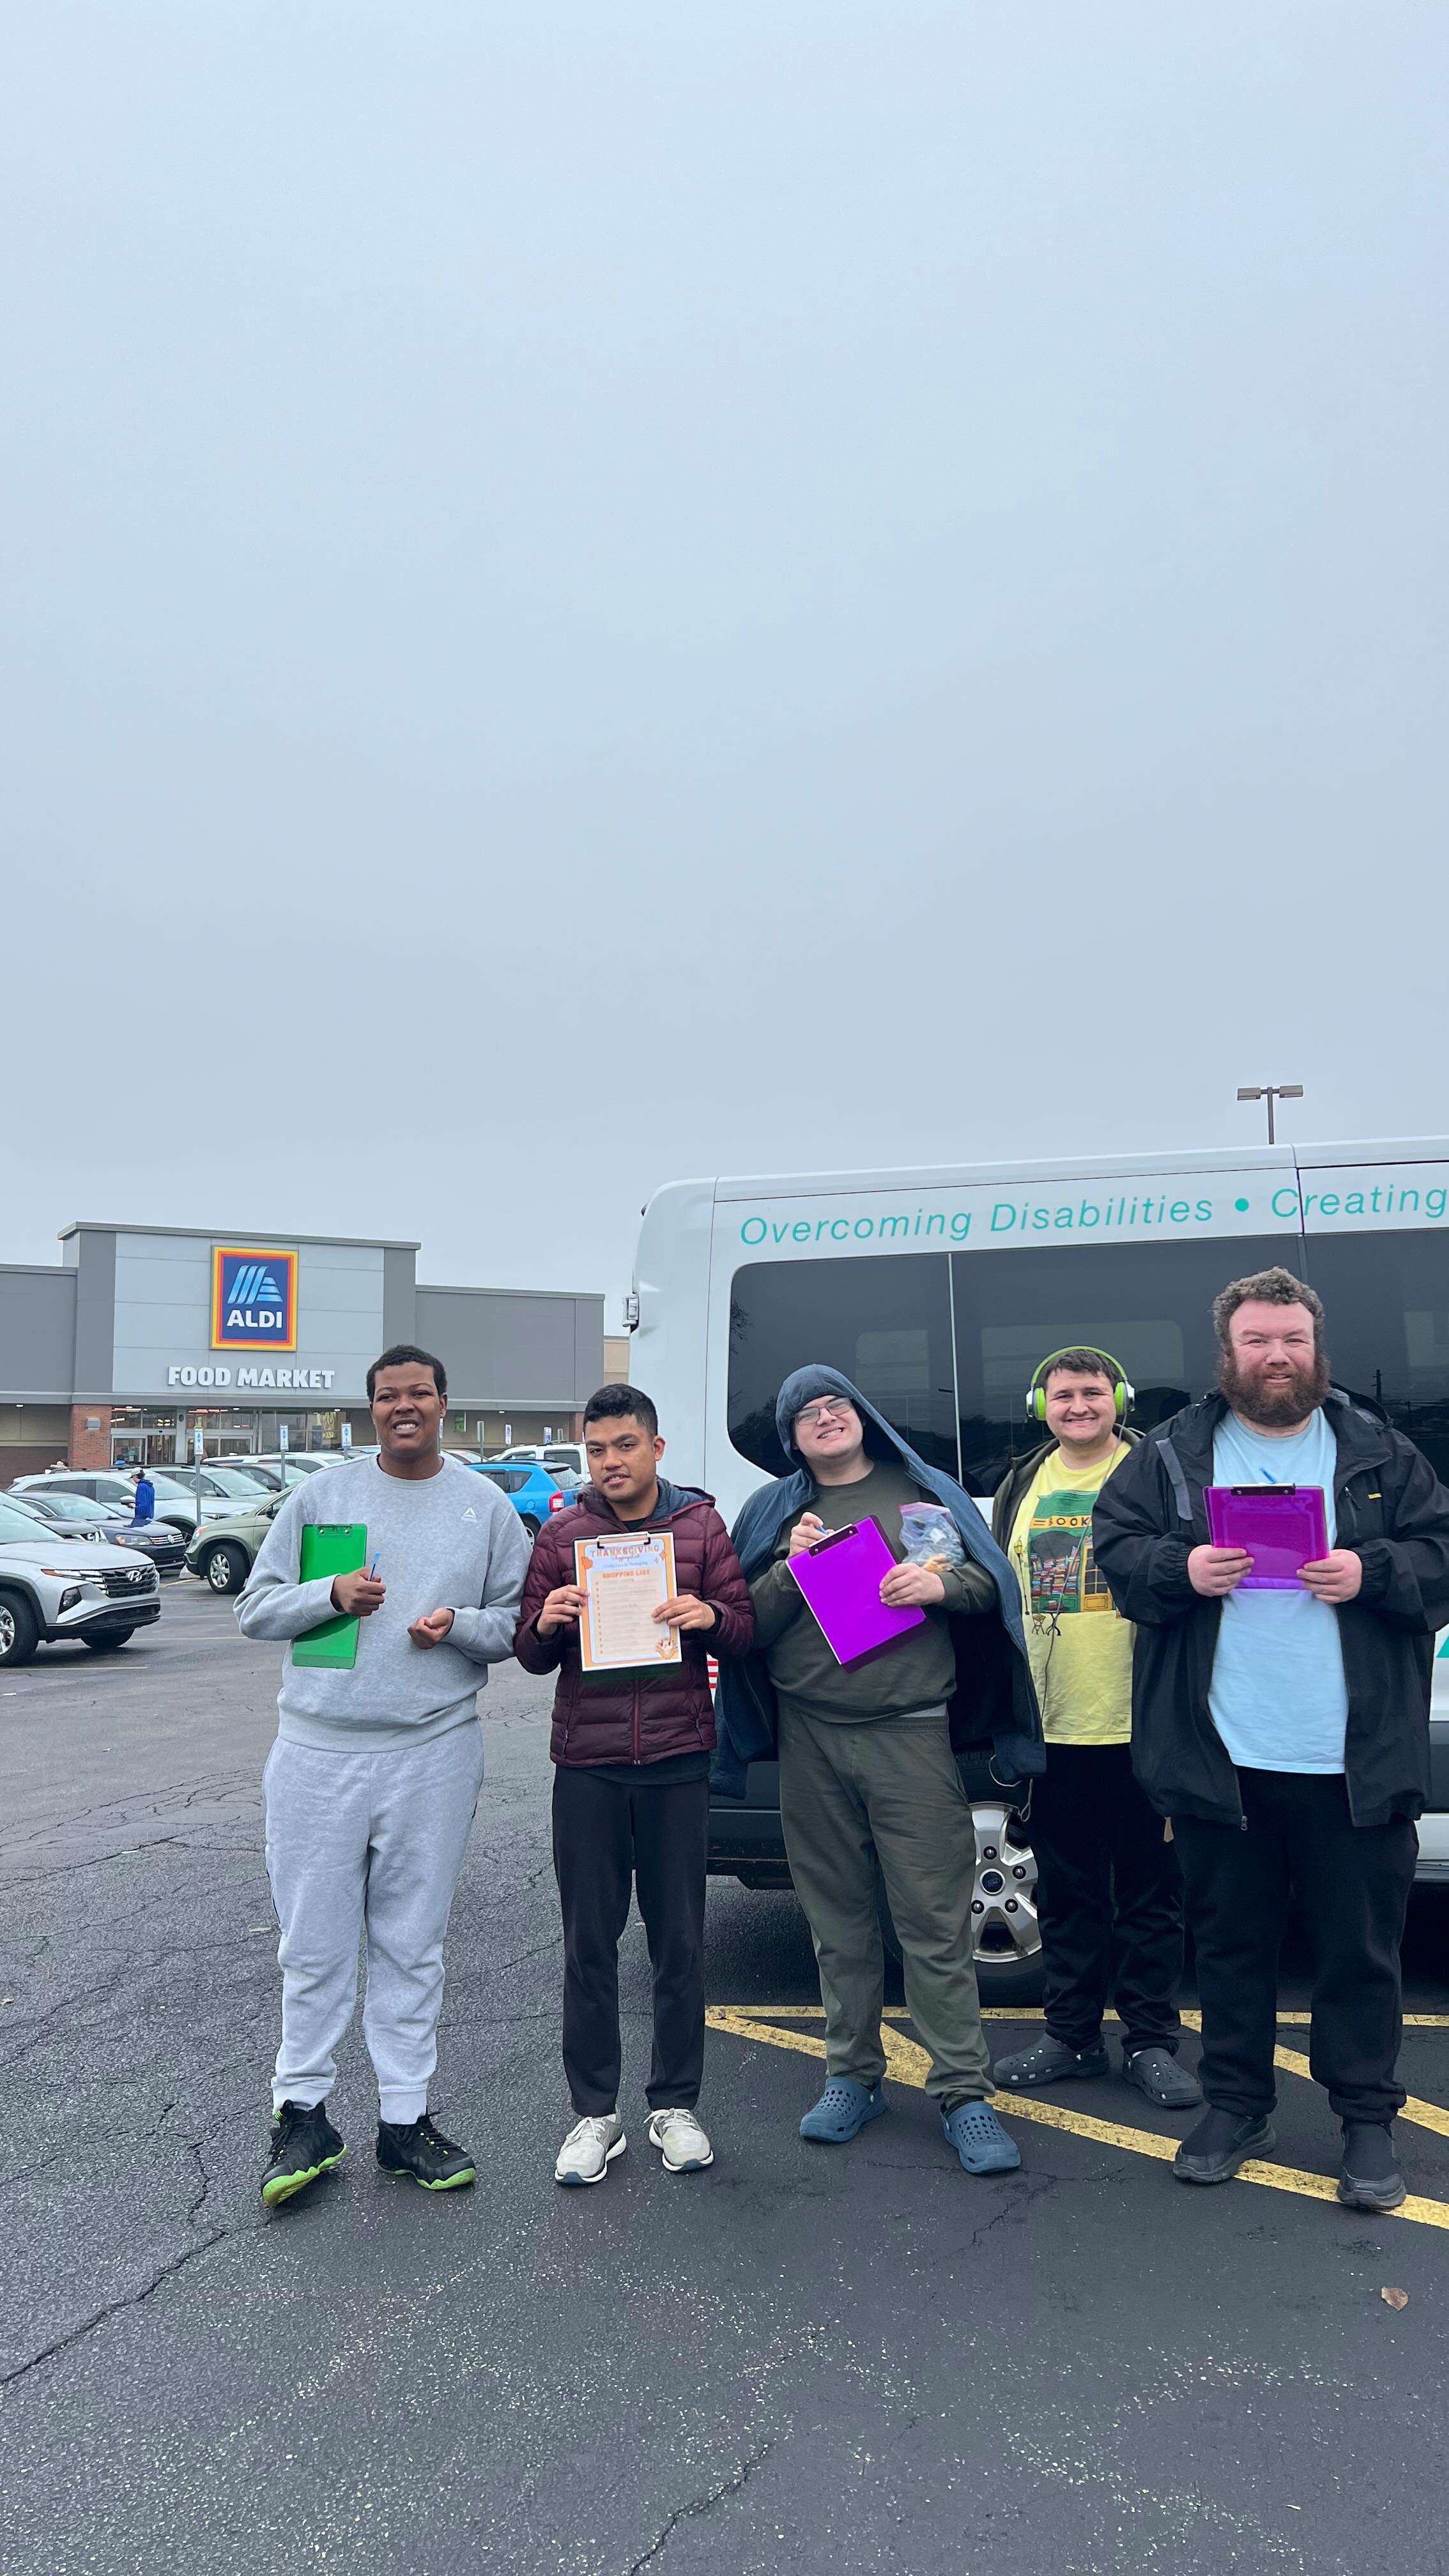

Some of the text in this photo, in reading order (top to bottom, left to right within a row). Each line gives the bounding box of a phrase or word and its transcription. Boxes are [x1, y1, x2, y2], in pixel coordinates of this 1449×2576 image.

[740, 1184, 1447, 1245] Overcoming Disabilities Creating
[226, 1309, 283, 1328] ALDI
[168, 1366, 335, 1388] FOOD MARKET
[590, 1545, 659, 1558] THANKSGIVING
